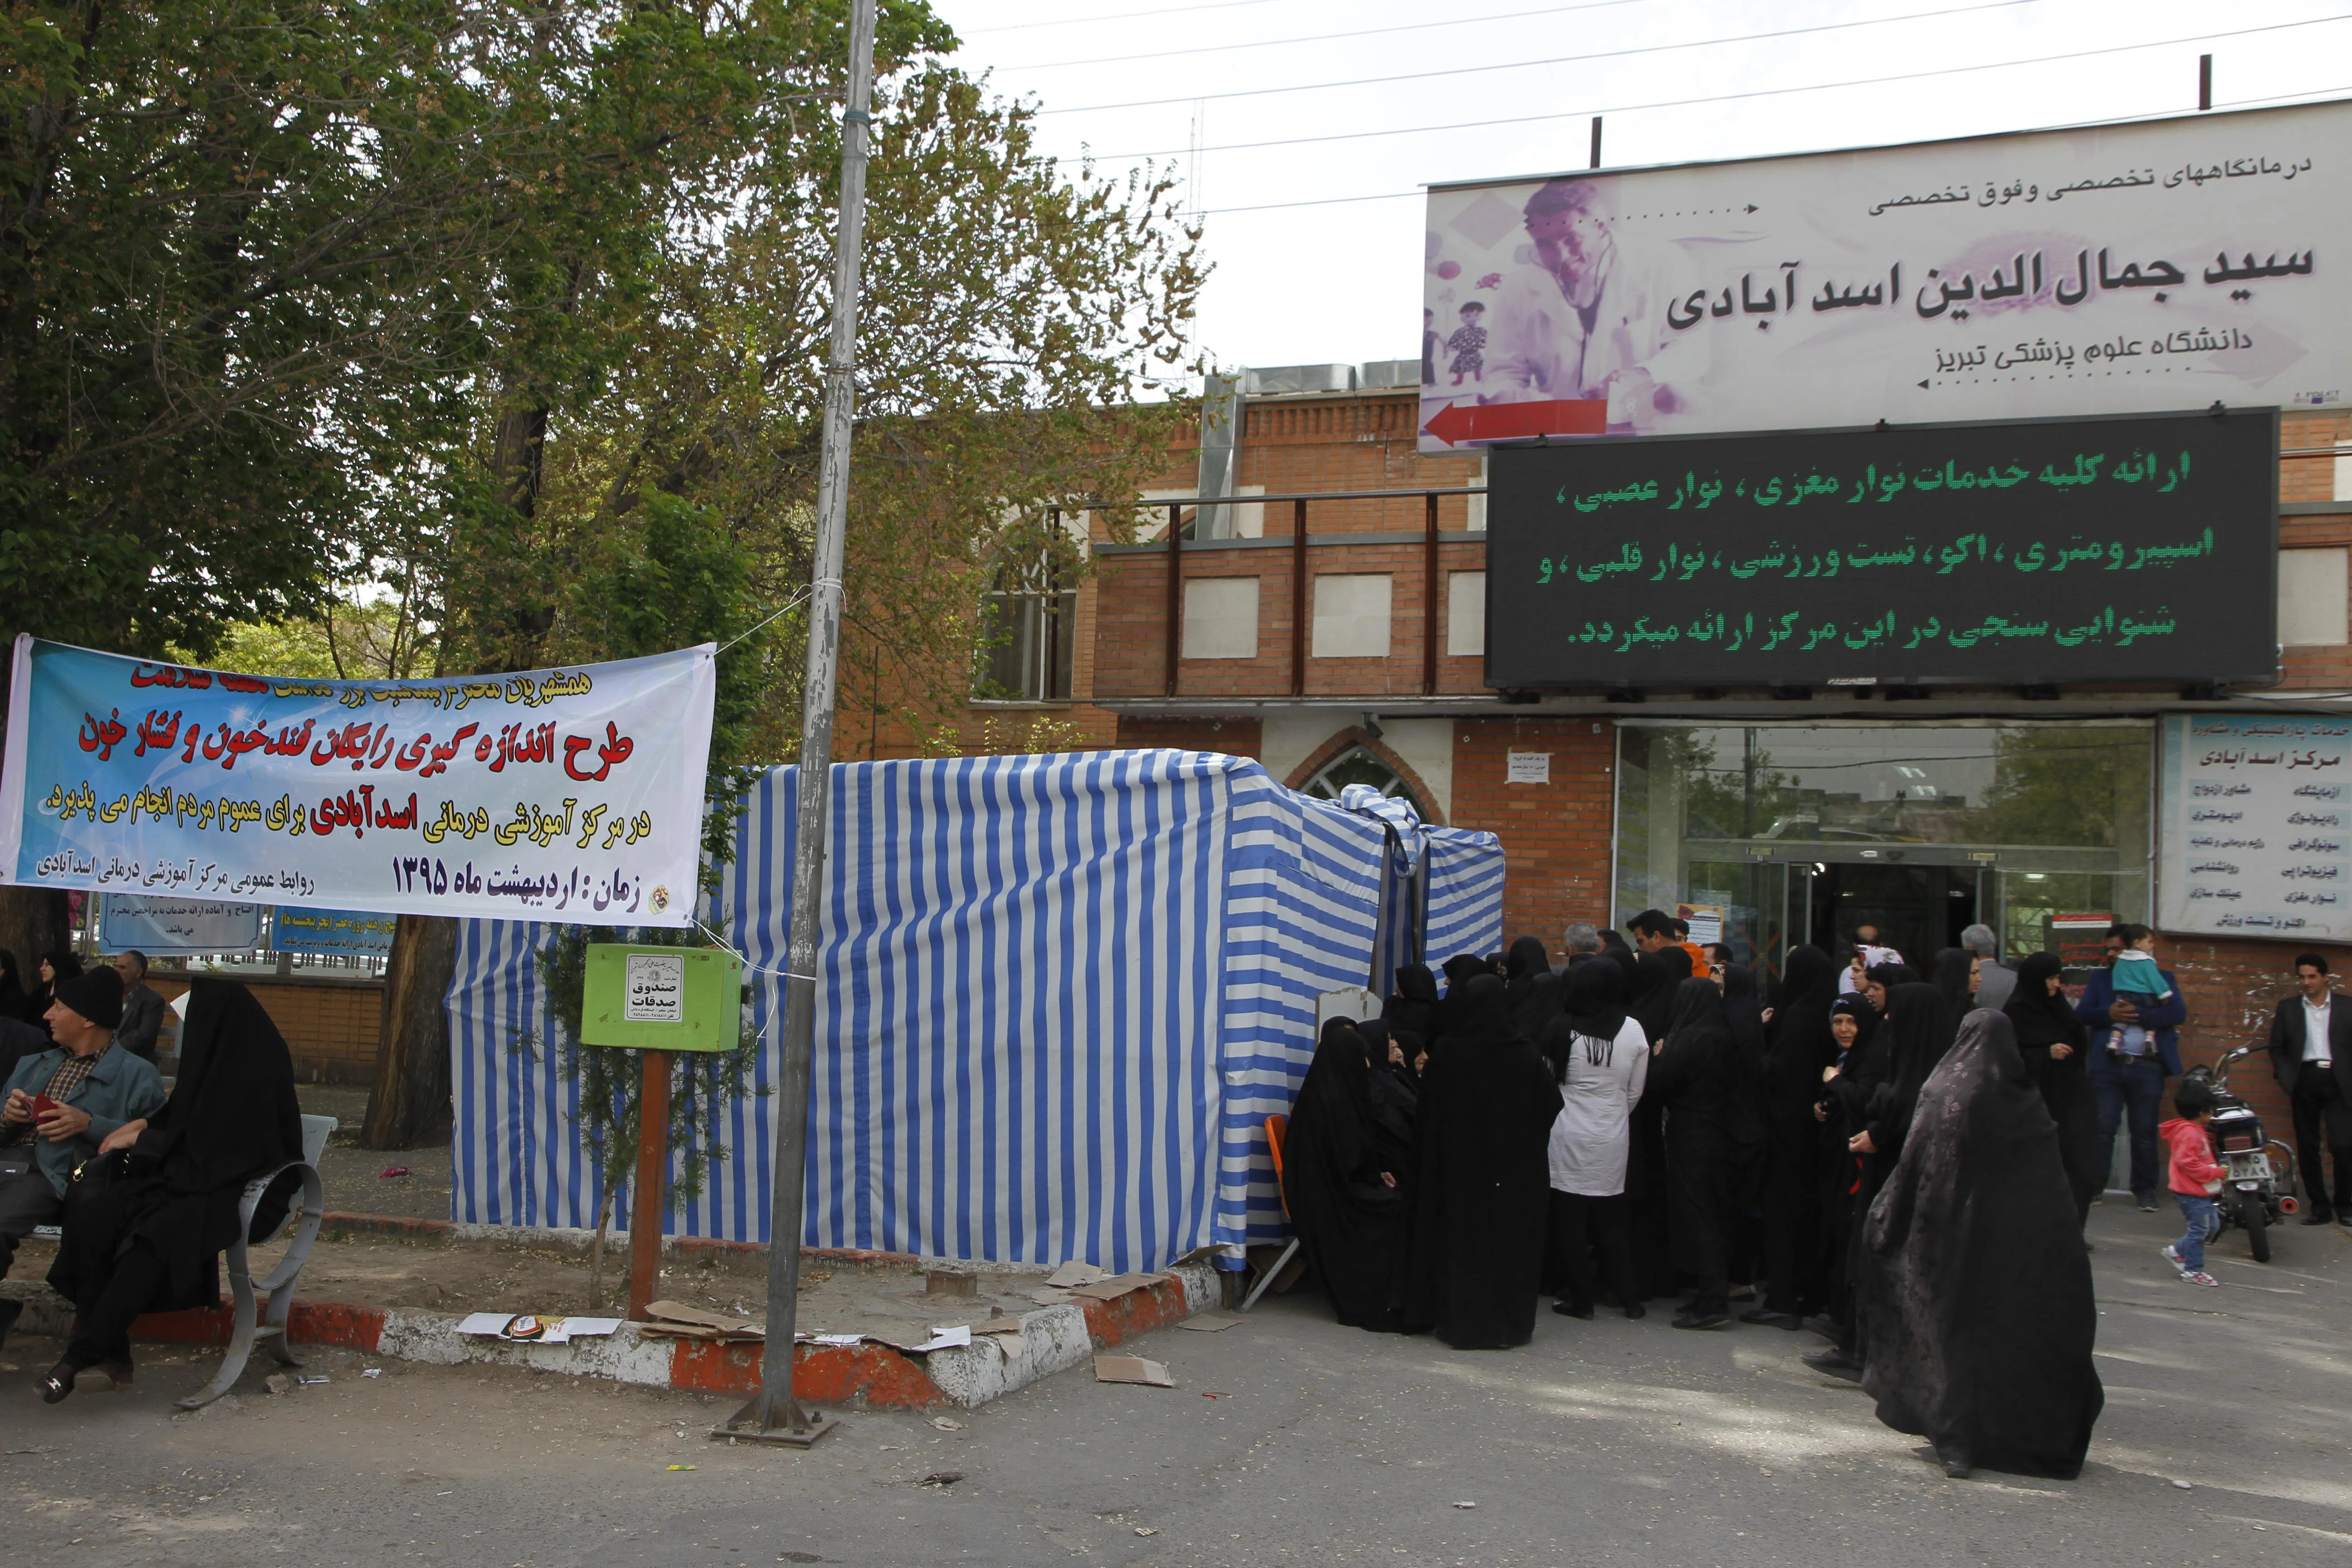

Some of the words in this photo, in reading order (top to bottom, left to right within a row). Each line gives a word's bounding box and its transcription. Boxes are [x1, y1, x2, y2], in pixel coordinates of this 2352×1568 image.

[2047, 169, 2155, 202] تخصصی
[2163, 157, 2312, 188] درمانگاههای
[1868, 186, 1970, 216] تخصصی
[1813, 261, 1901, 312] اسد
[1916, 248, 2043, 320] الدین
[2055, 246, 2185, 305] جمال
[2204, 248, 2313, 302] سید
[1666, 260, 1800, 333] آبادی
[1936, 344, 1986, 372] تبریز
[1995, 337, 2075, 370] پزشکی
[2084, 337, 2142, 363] علوم
[2151, 327, 2252, 353] دانشگاه
[1754, 466, 1838, 506] مغزی
[1846, 461, 1906, 503] نوار
[1913, 457, 2030, 490] خدمات
[2038, 453, 2105, 492] کلیه
[2112, 447, 2191, 492] ارائه
[1574, 479, 1658, 512] عصبی
[1667, 470, 1722, 509] نوار
[1577, 542, 1642, 582] قلبی
[1650, 542, 1705, 581] نوار
[1730, 540, 1840, 578] ورزشی
[1847, 536, 1916, 568] تست
[2014, 526, 2214, 572] اسپیرومتری
[1686, 608, 1753, 651] ارائه
[1760, 611, 1837, 650] مرکز
[1844, 609, 1896, 649] این
[1902, 617, 1941, 648] در
[1948, 612, 2048, 648] سنجی
[2054, 605, 2176, 647] شنوایی
[444, 683, 502, 710] محترم
[505, 671, 593, 708] همشهریان
[78, 708, 127, 761] خون
[134, 709, 183, 757] فشار
[181, 723, 201, 764] و
[310, 721, 395, 771] رایگان
[475, 720, 557, 772] اندازه
[2310, 723, 2350, 737] خدمات
[395, 721, 480, 778] گیری
[564, 720, 633, 781] طرح
[2200, 747, 2246, 769] آبادی
[2247, 750, 2284, 764] اسد
[2286, 750, 2341, 770] مرکز
[100, 793, 129, 823] می
[132, 784, 173, 824] انجام
[176, 794, 215, 829] مردم
[218, 797, 262, 832] عموم
[266, 793, 306, 837] برای
[423, 800, 489, 843] درمانی
[495, 798, 577, 847] آموزشی
[577, 803, 625, 850] مرکز
[626, 810, 652, 845] در
[98, 857, 140, 883] درمانی
[143, 858, 195, 890] آموزشی
[196, 863, 229, 892] مرکز
[230, 872, 274, 895] عمومی
[279, 870, 314, 896] روابط
[392, 856, 448, 896] ۱۳۹۵
[454, 861, 482, 895] ماه
[487, 864, 578, 910] اردیبهشت
[110, 906, 131, 917] محترم
[165, 905, 187, 915] خدمات
[206, 904, 224, 914] آماده
[632, 983, 676, 995] صندوق
[632, 995, 676, 1007] صدقات
